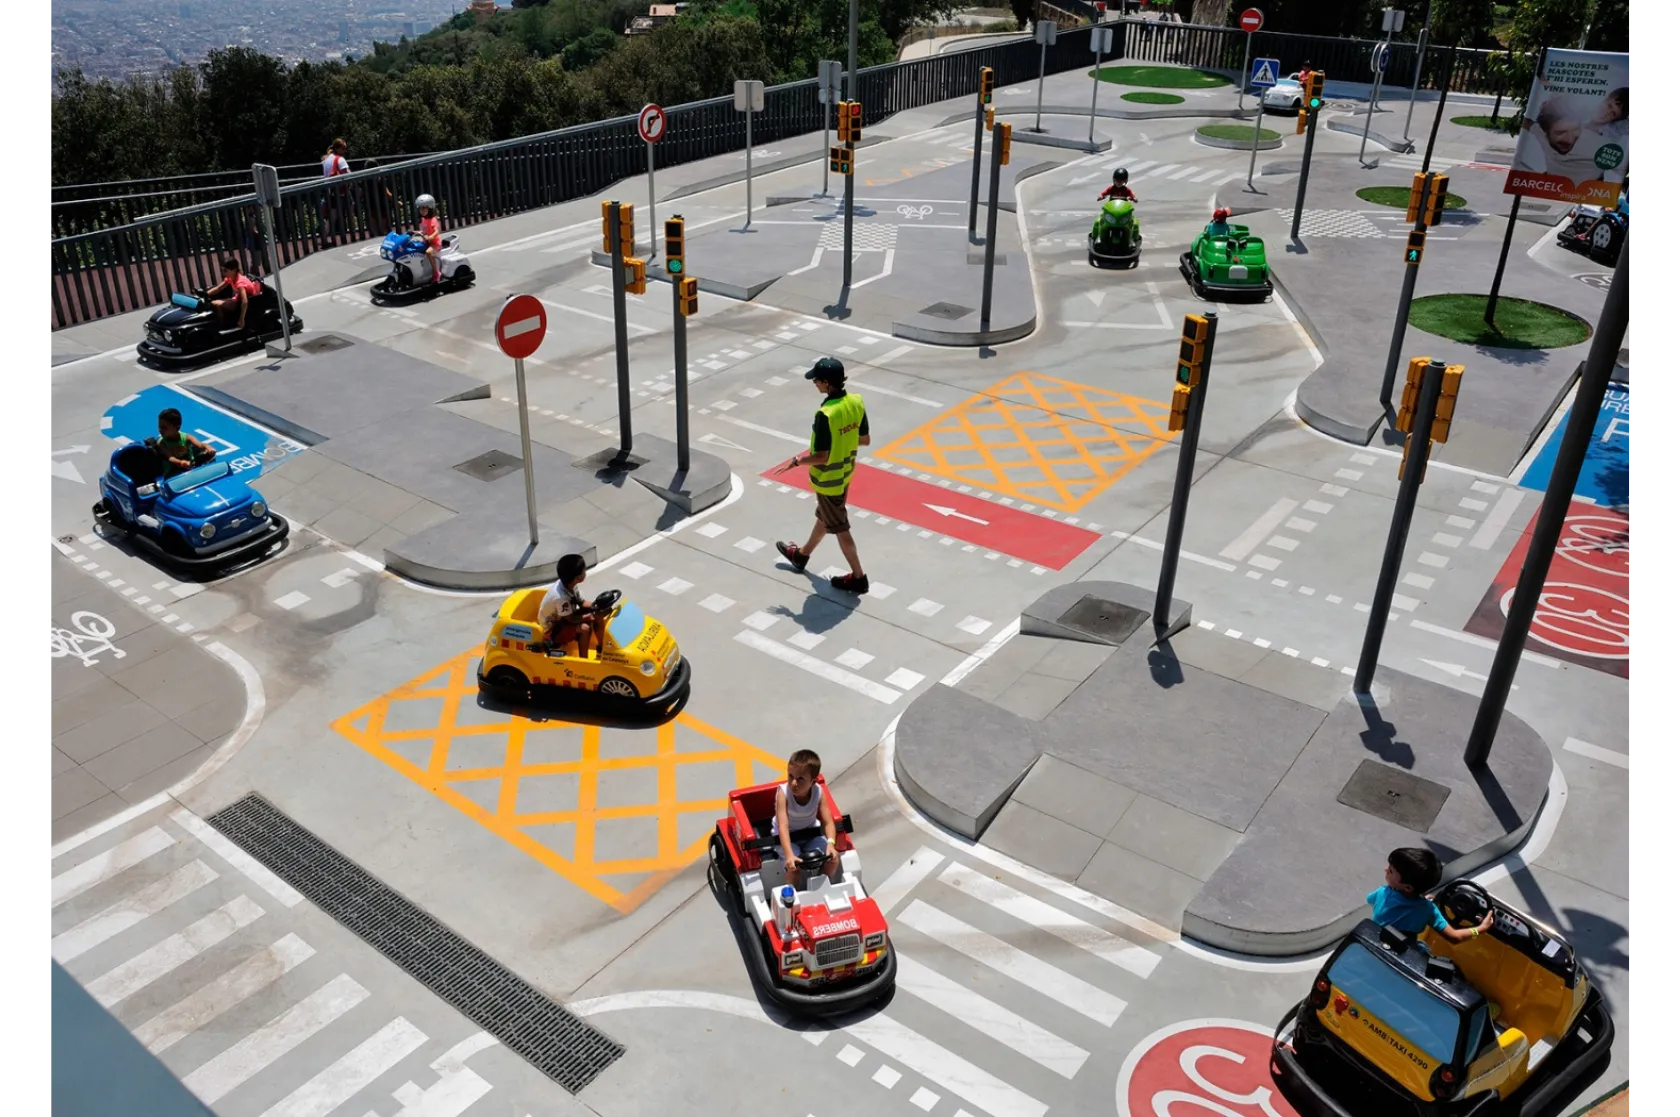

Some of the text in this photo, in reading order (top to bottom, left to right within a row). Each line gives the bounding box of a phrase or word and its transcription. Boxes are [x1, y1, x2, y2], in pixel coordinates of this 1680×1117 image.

[1568, 62, 1609, 71] NOSTRES
[1547, 68, 1596, 77] MASCOTES
[1565, 77, 1609, 86] ESPEREN.
[1544, 85, 1607, 96] VINE VOLANT!
